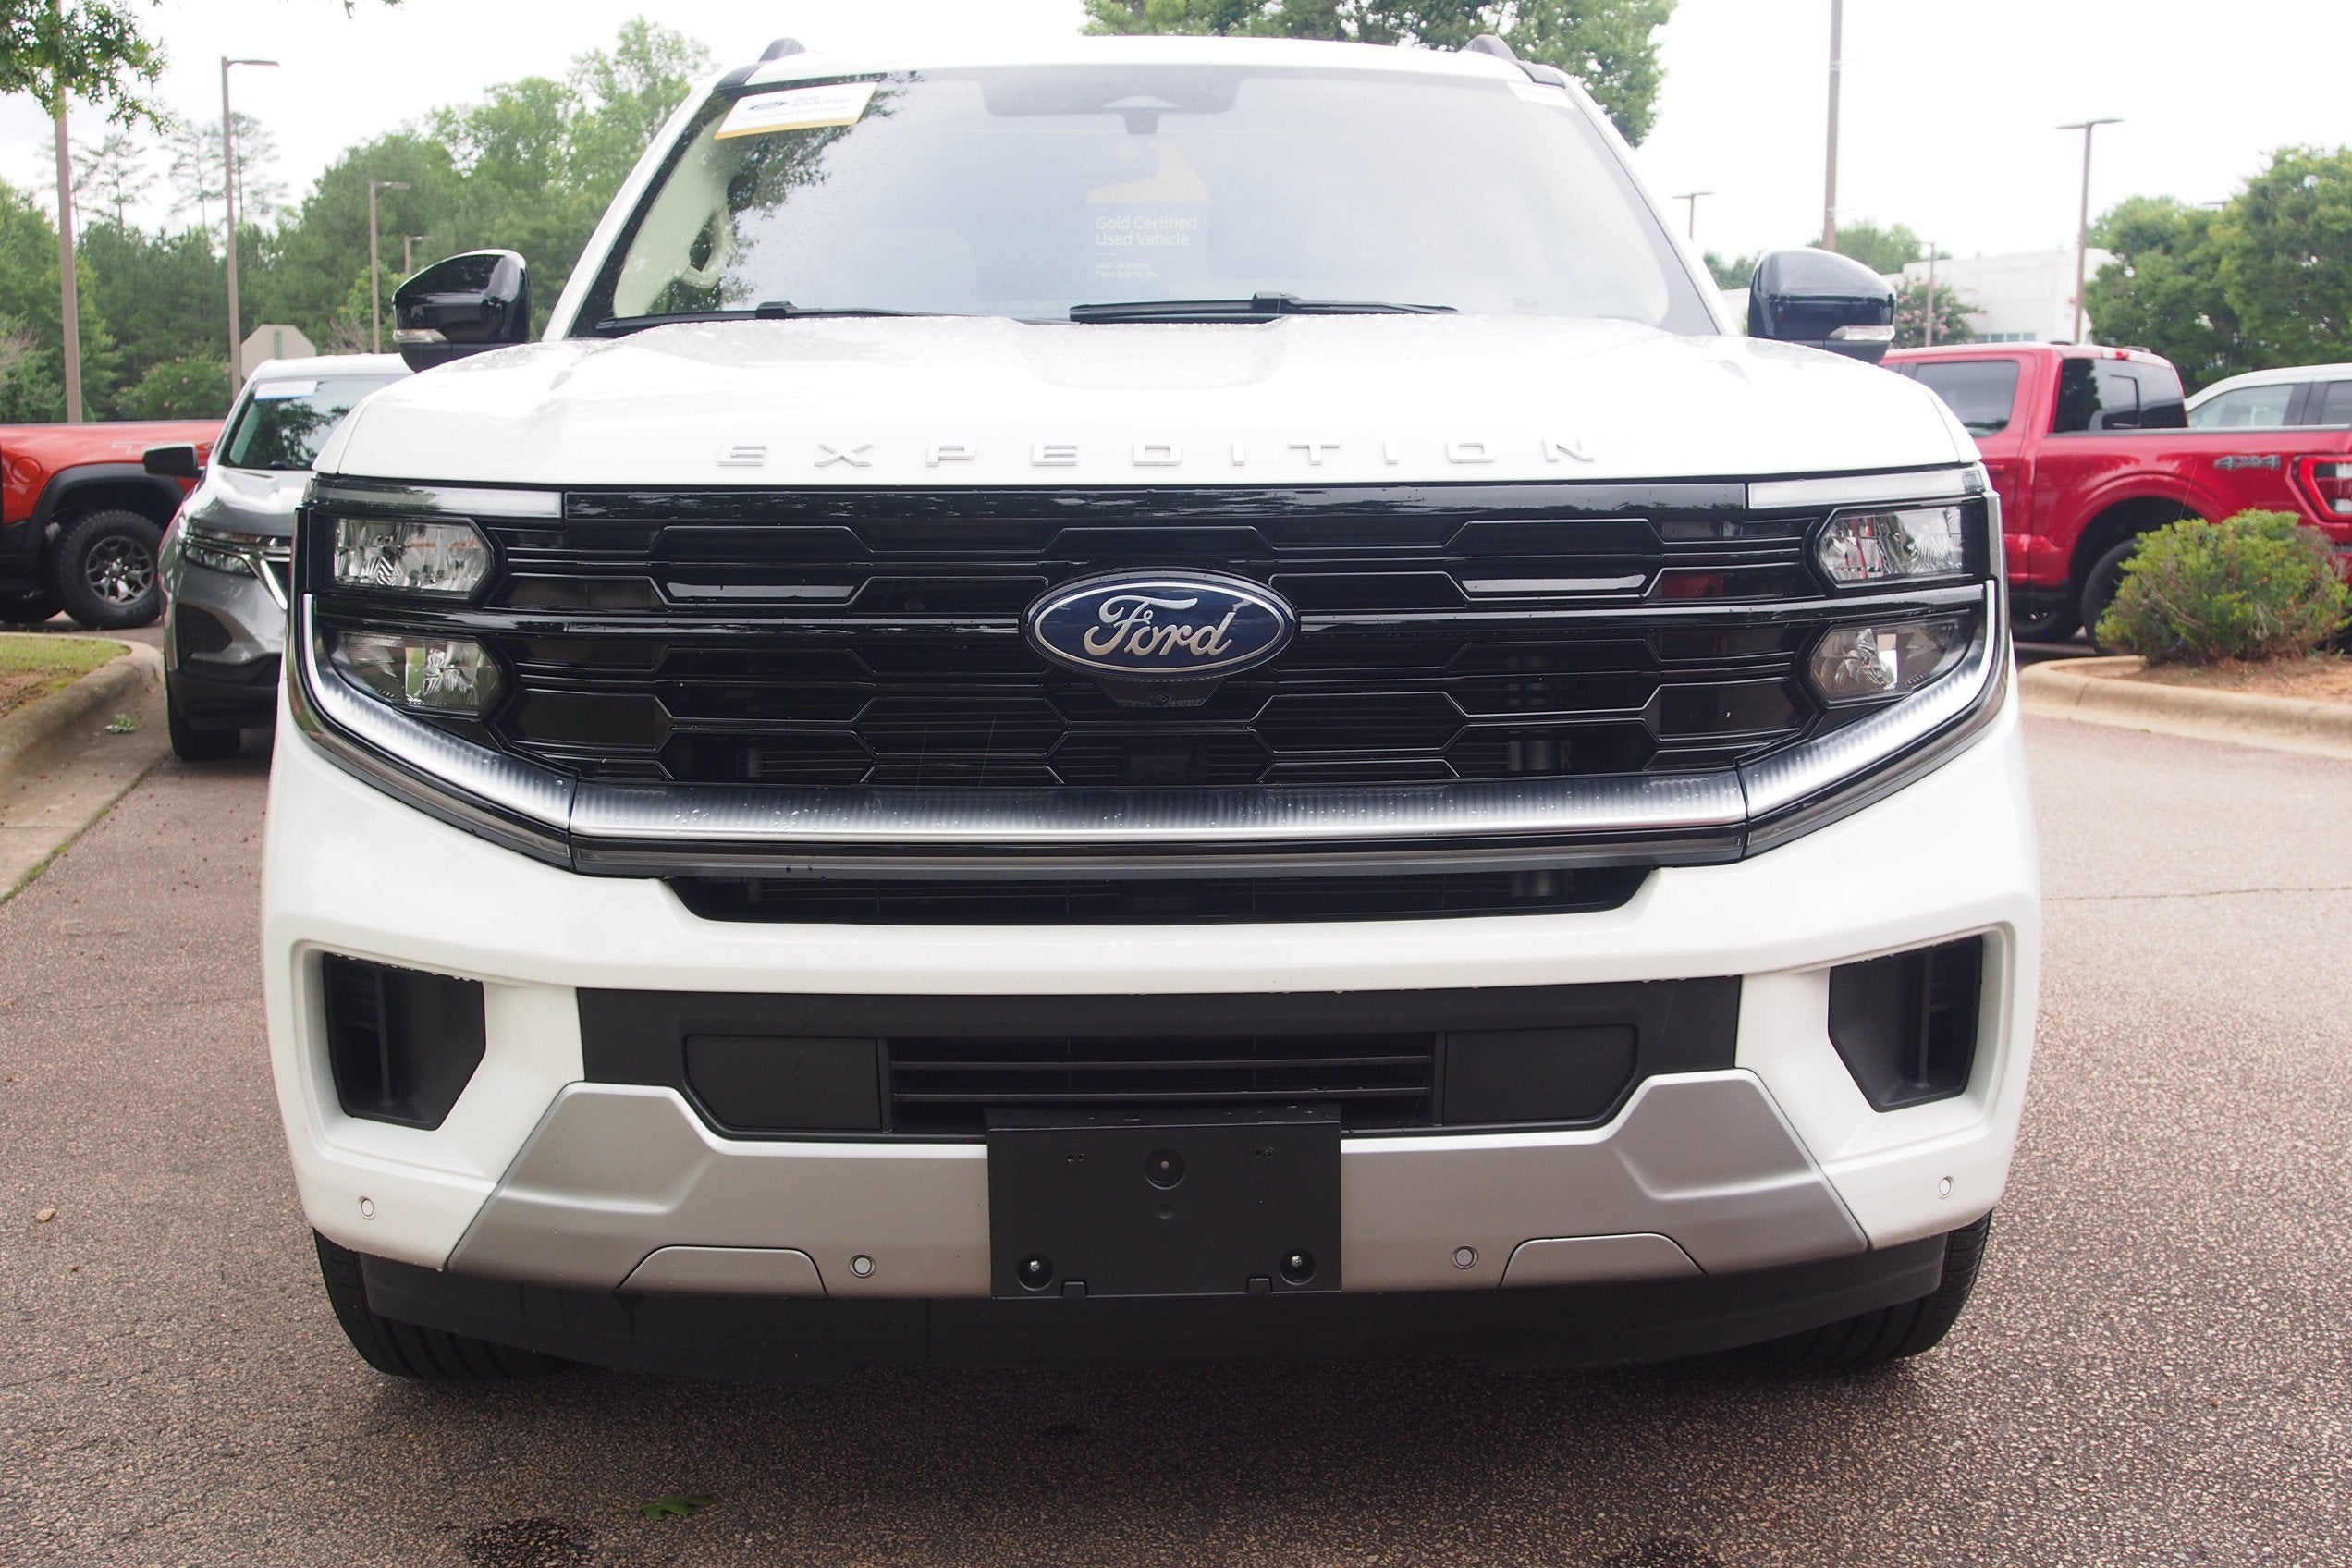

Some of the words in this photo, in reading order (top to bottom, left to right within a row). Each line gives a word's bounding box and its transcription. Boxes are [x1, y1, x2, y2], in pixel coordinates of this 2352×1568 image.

[1096, 215, 1131, 230] Gold
[1133, 215, 1198, 230] Certified
[1096, 232, 1133, 246] Used
[1136, 232, 1191, 246] Vehicle
[717, 438, 1596, 467] EXPEDITION
[1084, 594, 1233, 656] Ford
